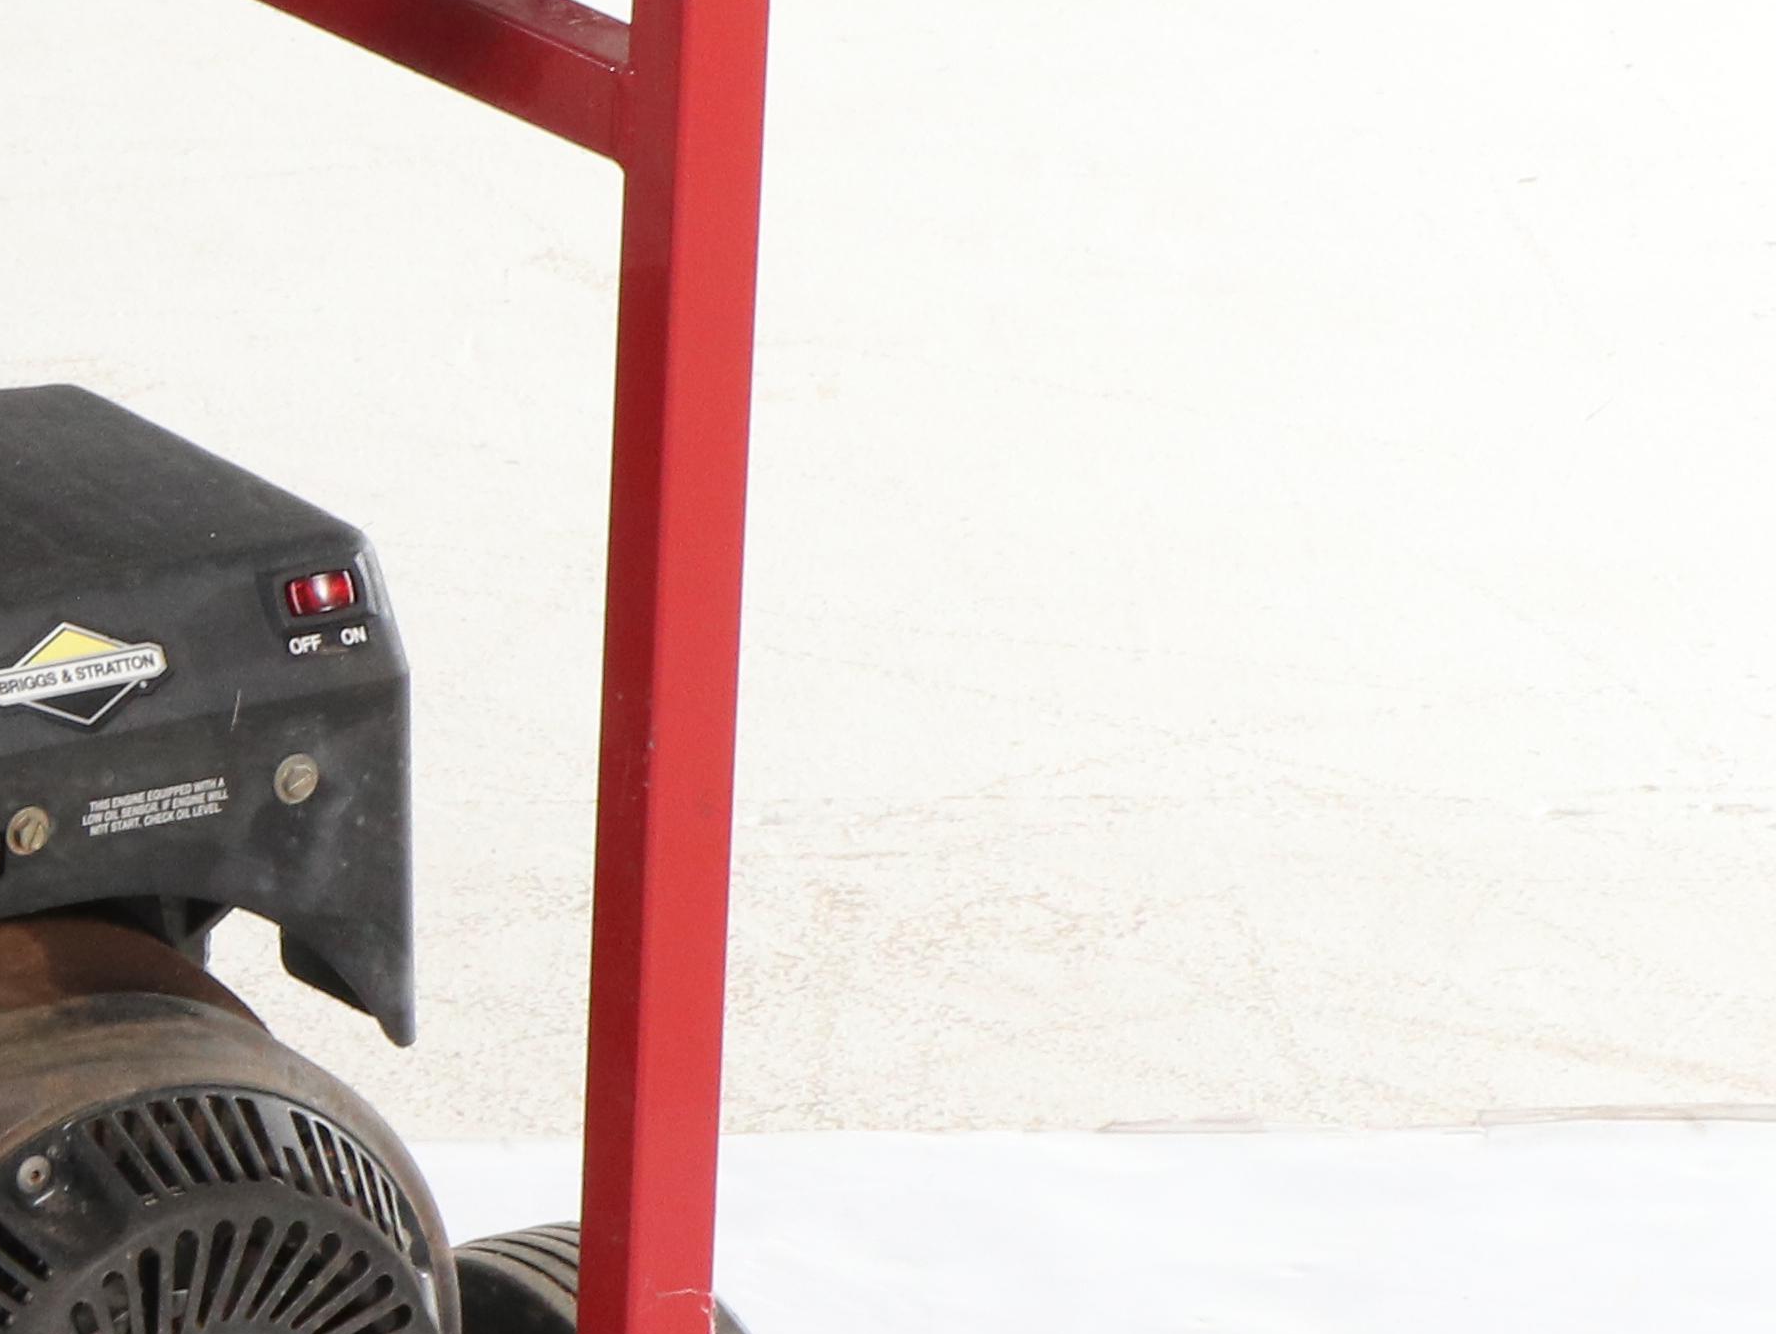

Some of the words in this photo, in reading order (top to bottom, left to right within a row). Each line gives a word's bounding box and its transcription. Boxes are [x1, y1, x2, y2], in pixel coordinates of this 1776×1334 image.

[289, 632, 322, 655] OFF
[340, 625, 368, 646] ON
[61, 669, 73, 684] &
[75, 653, 156, 680] STRATTON
[82, 812, 103, 827] LOW
[104, 809, 119, 822] OIL
[161, 798, 172, 811] IF
[172, 792, 206, 809] ENGINE
[207, 788, 229, 802] WILL
[90, 798, 110, 812] THIS
[112, 792, 145, 809] ENGINE
[147, 782, 192, 802] EQUIPPED
[193, 778, 216, 793] WITH
[218, 776, 226, 787] A
[89, 823, 109, 837] NOT
[144, 811, 175, 827] CHECK
[176, 808, 191, 821] OIL
